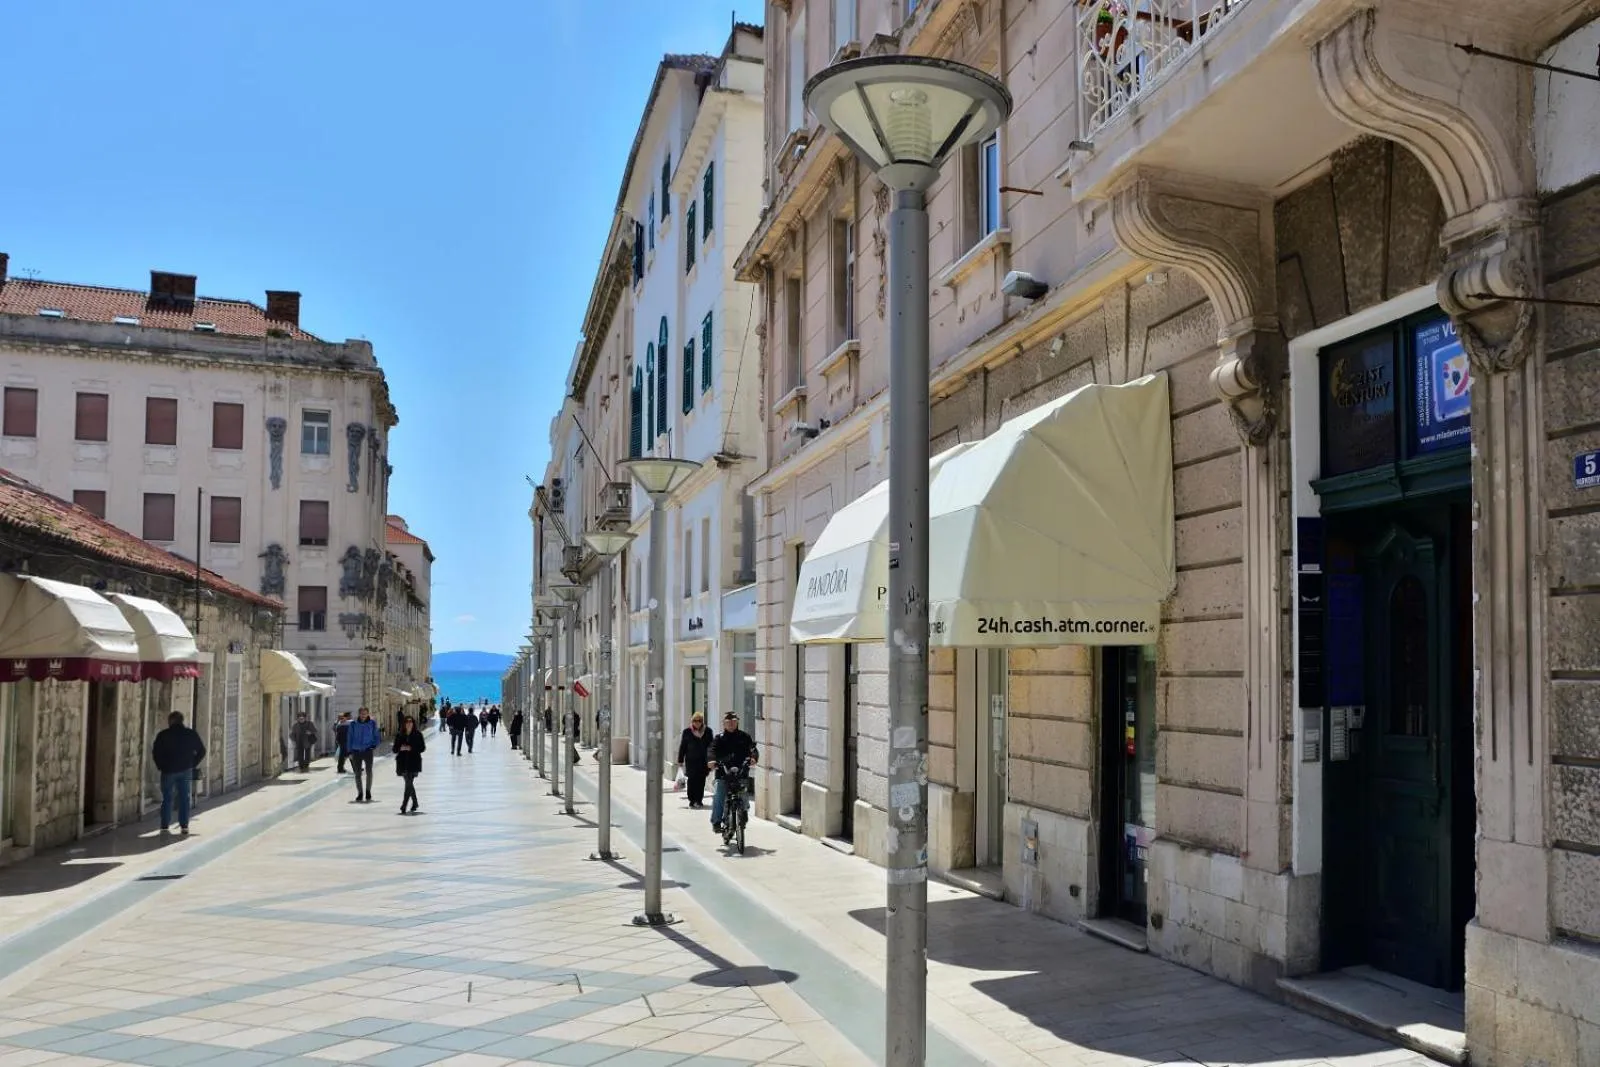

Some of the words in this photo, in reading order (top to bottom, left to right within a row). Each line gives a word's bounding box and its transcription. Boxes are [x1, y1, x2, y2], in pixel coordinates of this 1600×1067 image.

[1337, 383, 1391, 408] CENTURY
[1585, 453, 1597, 475] 5
[807, 567, 849, 599] PANDORA
